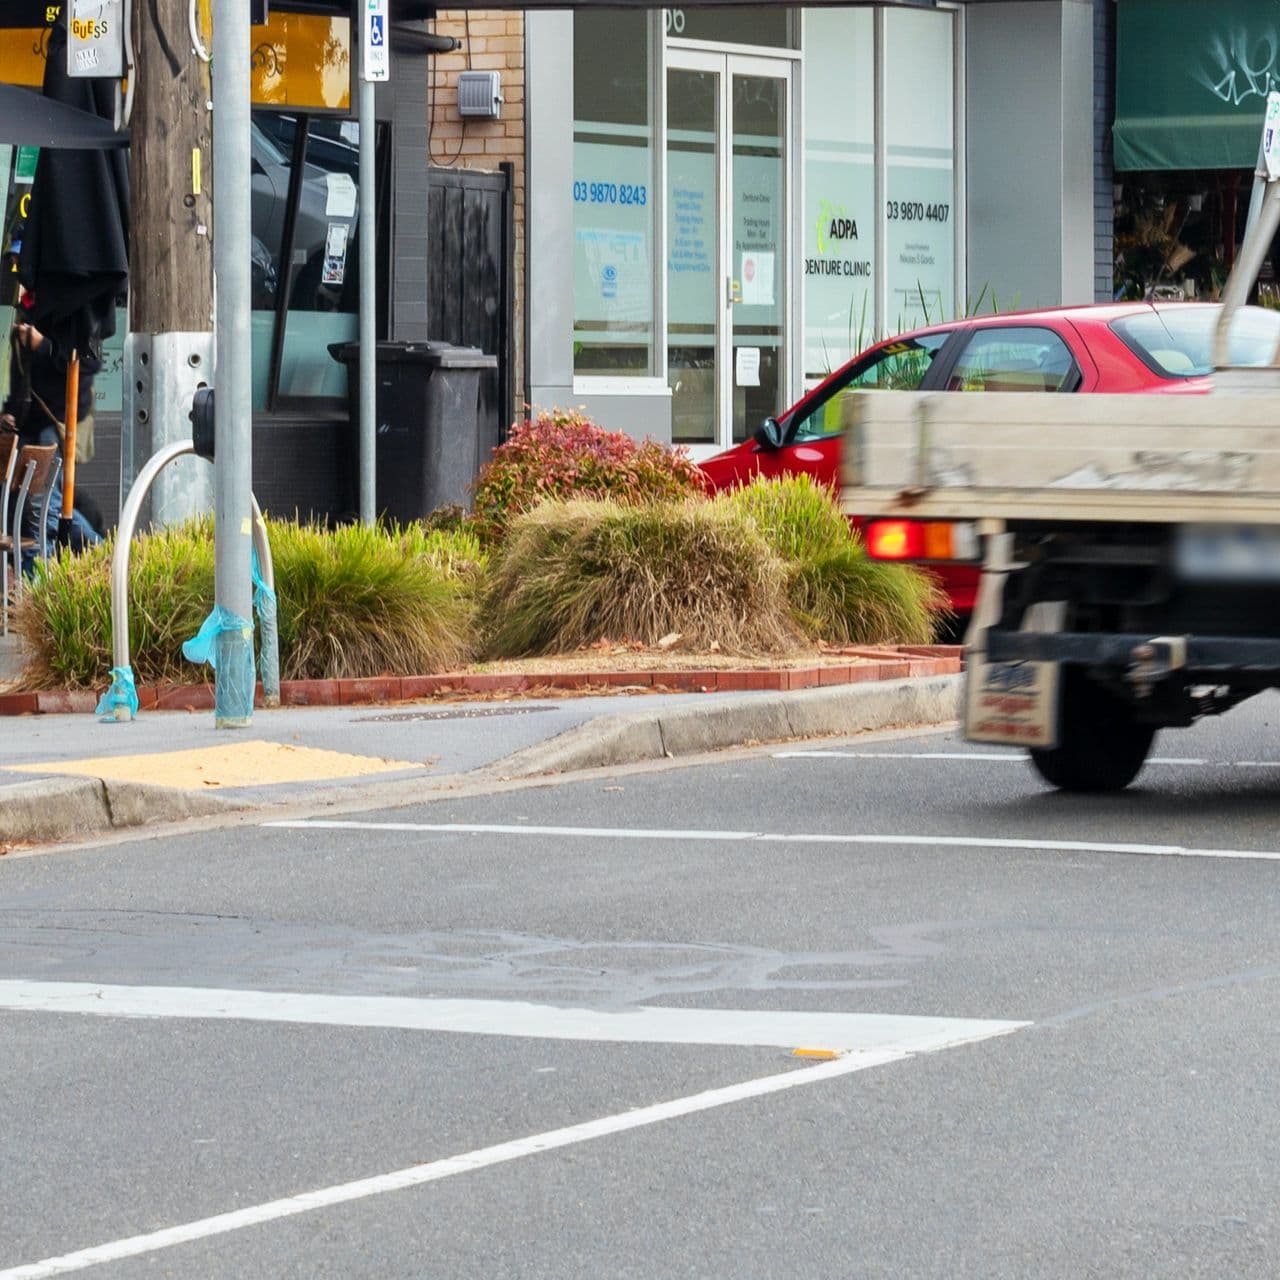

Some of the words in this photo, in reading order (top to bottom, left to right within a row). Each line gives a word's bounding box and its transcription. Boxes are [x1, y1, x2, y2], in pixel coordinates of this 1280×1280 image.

[72, 19, 109, 40] GUESS
[573, 181, 588, 203] 03
[589, 182, 618, 205] 9870
[619, 183, 647, 206] 8243
[886, 200, 899, 220] 03
[901, 201, 924, 221] 9870
[926, 203, 950, 223] 4407
[829, 218, 859, 240] ADPA
[805, 258, 842, 276] DENTURE
[843, 260, 871, 277] CLINIC
